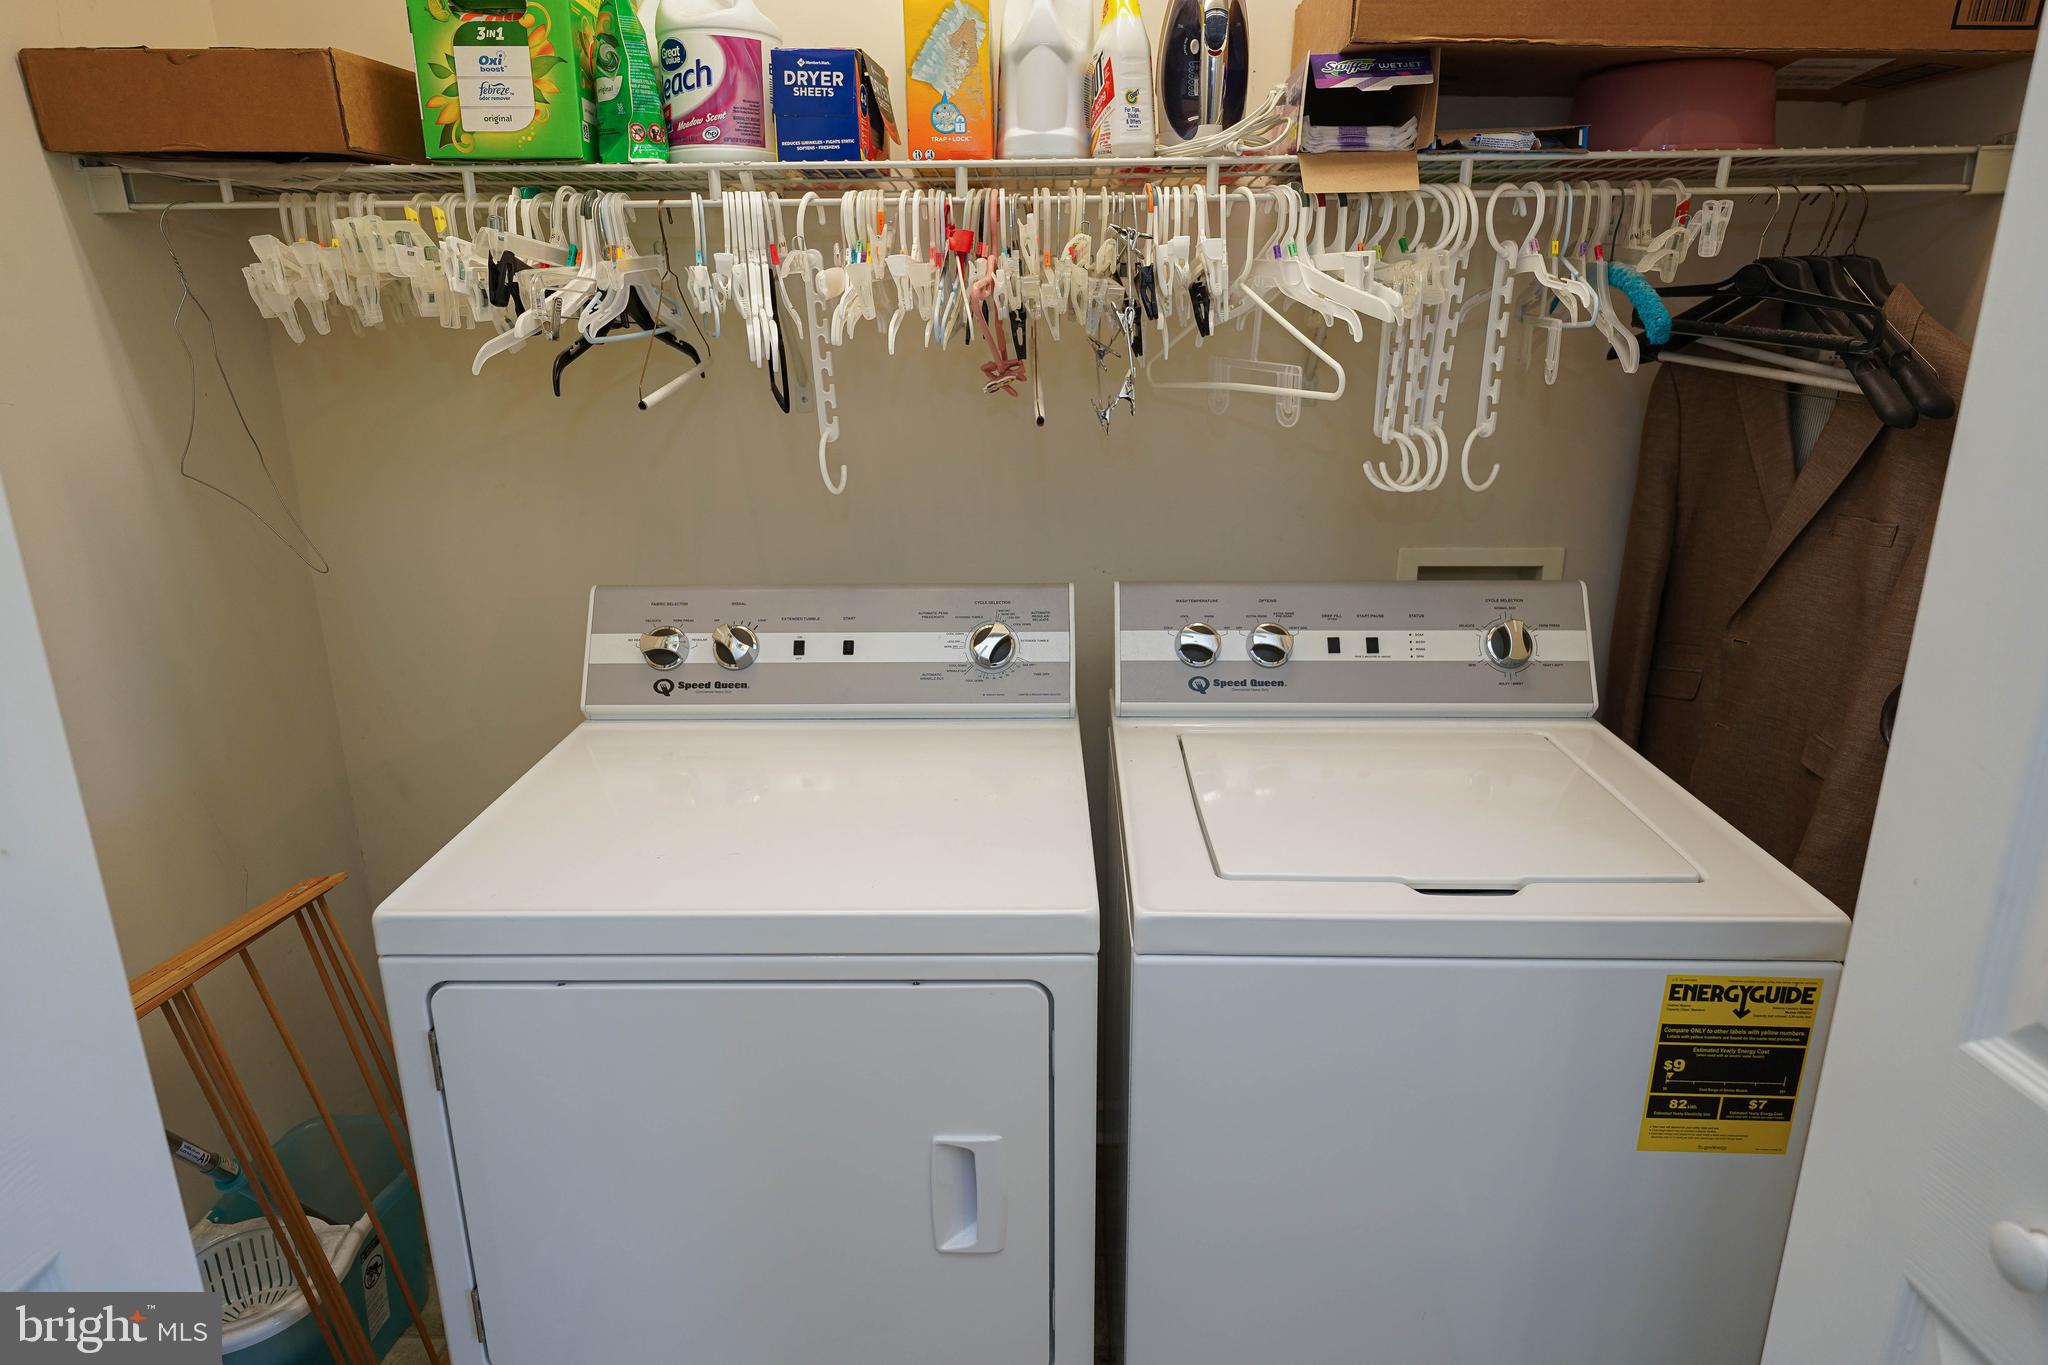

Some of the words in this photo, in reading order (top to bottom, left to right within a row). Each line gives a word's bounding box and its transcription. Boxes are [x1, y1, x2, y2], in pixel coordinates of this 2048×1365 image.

[662, 46, 681, 57] Great
[478, 53, 502, 66] Oxi
[1321, 60, 1375, 74] Swiffer
[783, 70, 844, 86] DRYER
[479, 81, 510, 96] febreze
[793, 87, 834, 97] SHEETS
[483, 115, 513, 124] original
[705, 111, 727, 123] Scent
[678, 681, 711, 690] Speed
[714, 681, 747, 689] Queen
[1213, 679, 1247, 688] Speed
[1250, 679, 1284, 687] Queen
[1668, 983, 1817, 1006] ENERGYGUIDE
[1663, 1059, 1686, 1072] $9
[1669, 1099, 1687, 1109] 82
[1748, 1099, 1768, 1109] $7
